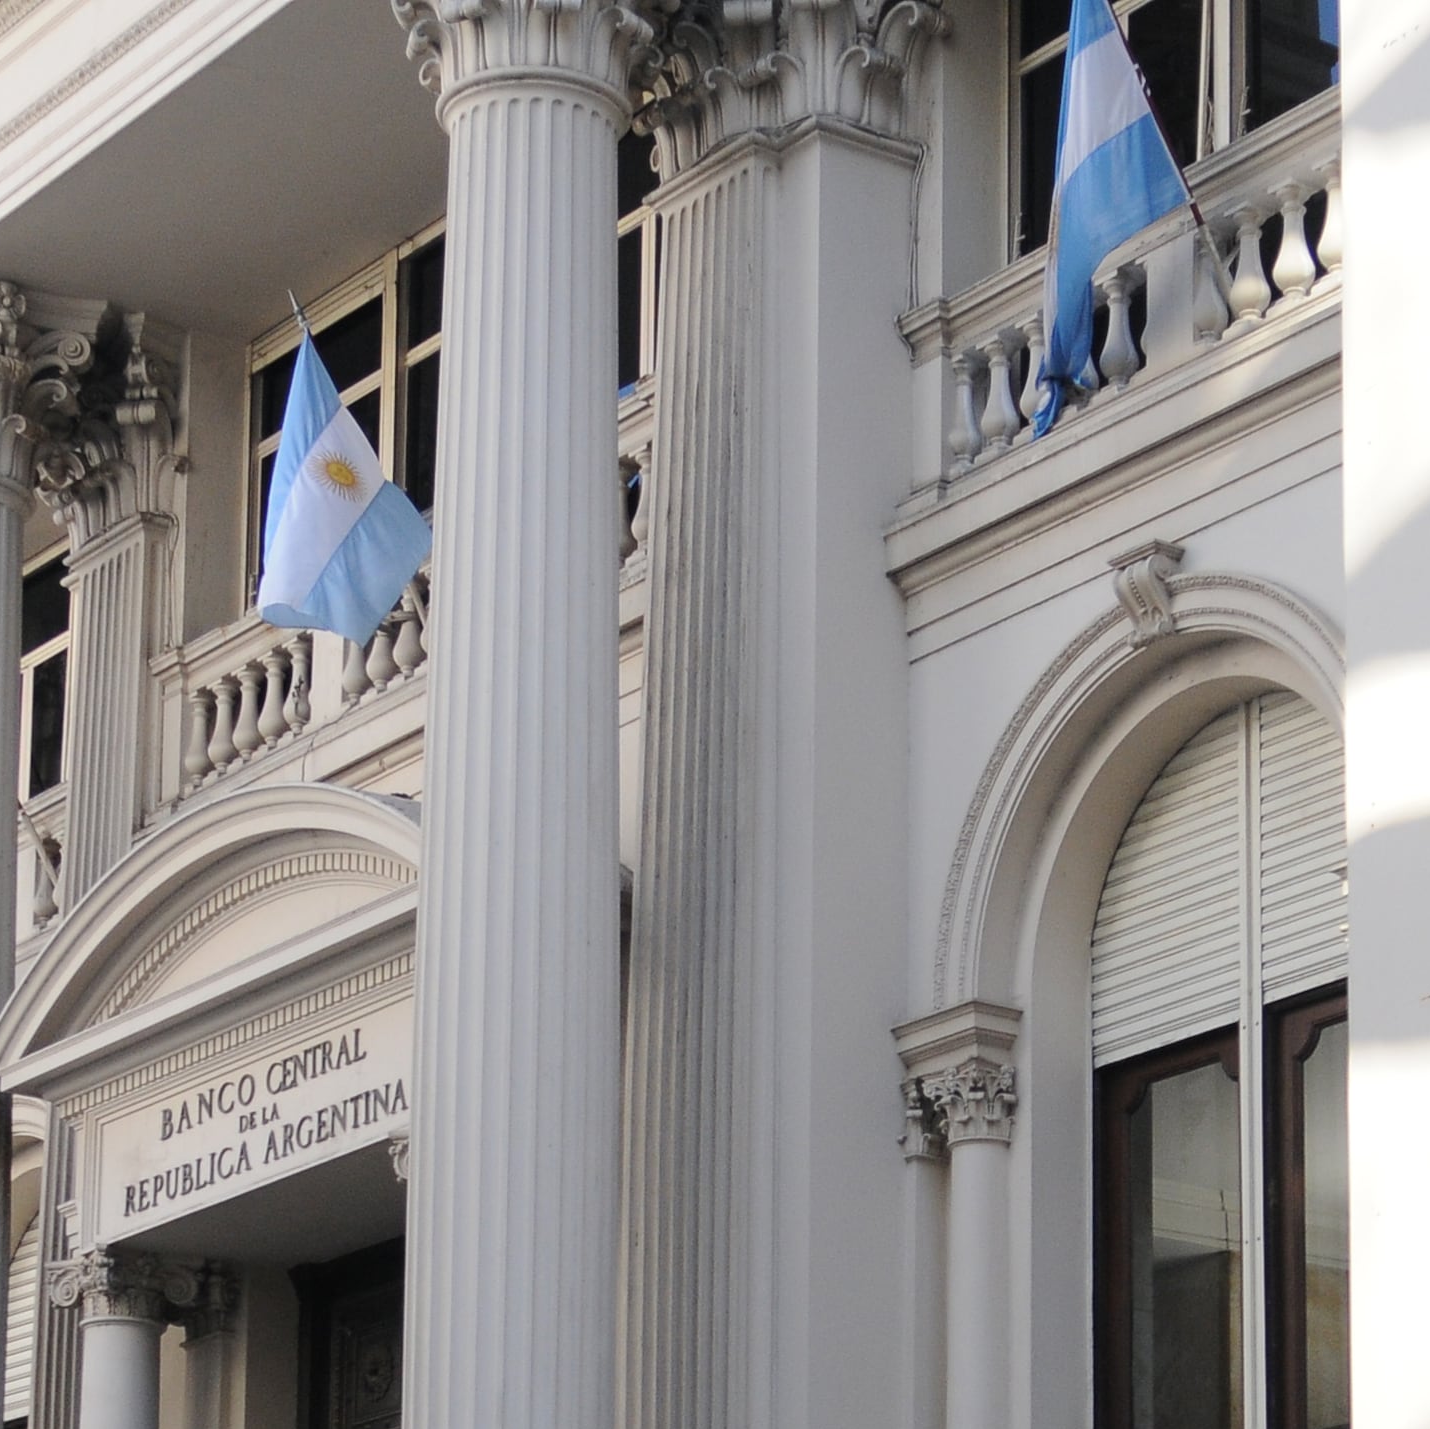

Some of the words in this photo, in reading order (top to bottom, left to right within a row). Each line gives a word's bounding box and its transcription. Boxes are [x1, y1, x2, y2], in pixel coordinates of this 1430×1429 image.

[159, 1073, 256, 1142] BANCO
[266, 1027, 367, 1095] CENTRAL
[238, 1111, 258, 1134] DE
[260, 1102, 280, 1126] LA
[123, 1140, 252, 1217] REPUBLICA
[262, 1077, 409, 1165] ARGENTINA
